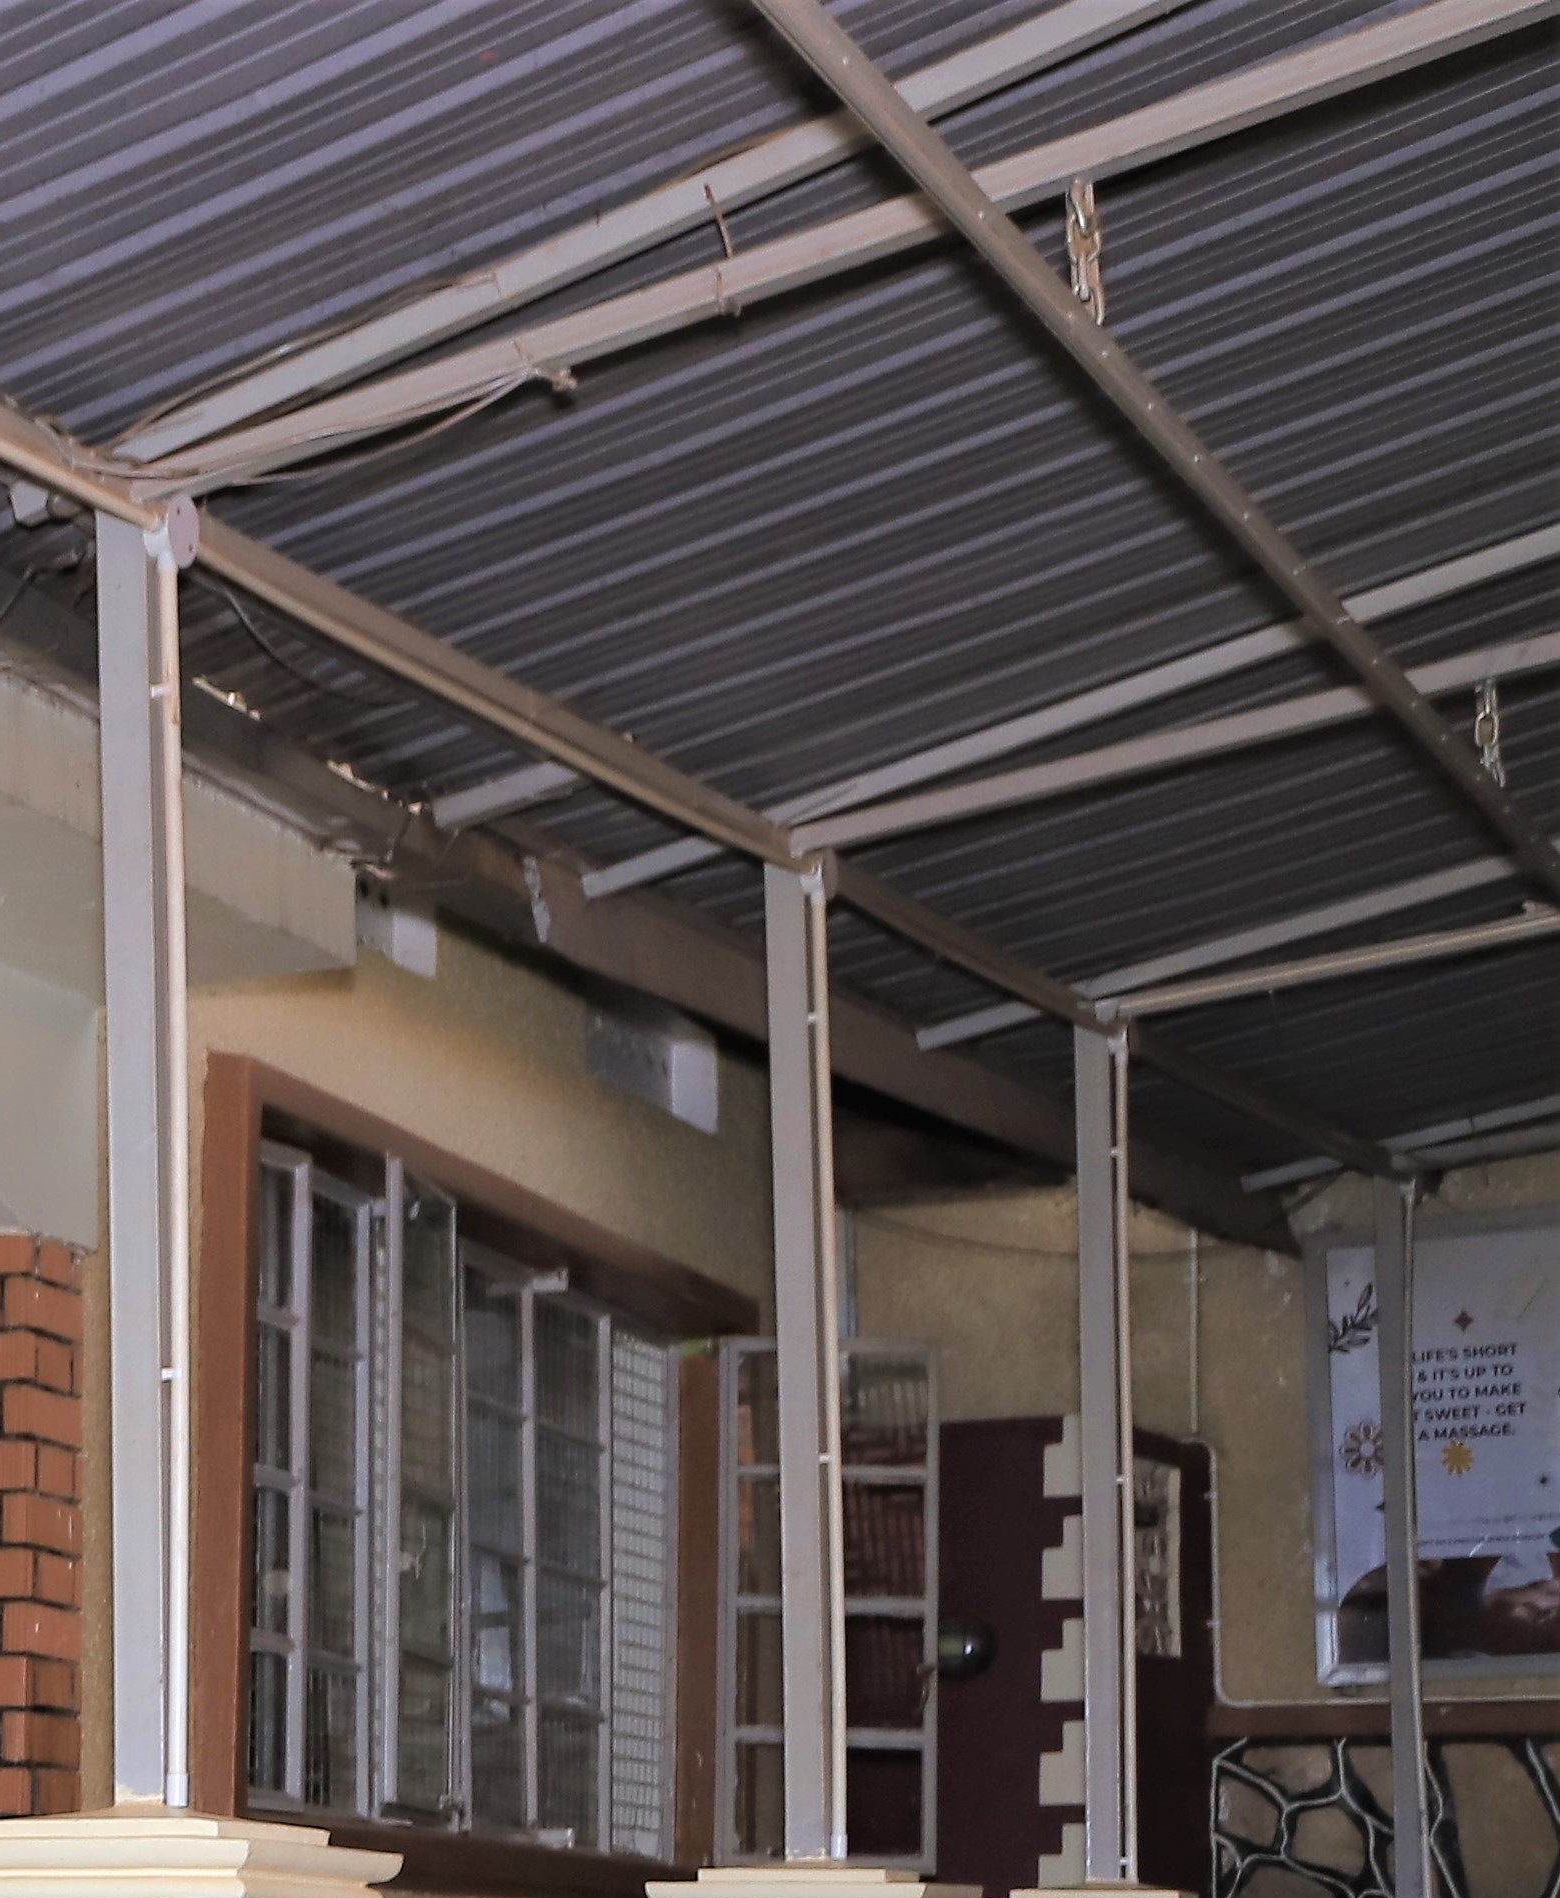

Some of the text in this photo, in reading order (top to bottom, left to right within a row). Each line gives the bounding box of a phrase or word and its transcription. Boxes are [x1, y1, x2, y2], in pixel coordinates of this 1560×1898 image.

[1412, 1342, 1517, 1363] LIFE'S SHORT
[1417, 1363, 1513, 1382] & IT'S UP TO
[1413, 1382, 1521, 1401] YOU TO MAKE
[1424, 1405, 1480, 1422] SWEET
[1496, 1402, 1526, 1416] GET
[1418, 1422, 1516, 1441] A MASSAGE.
